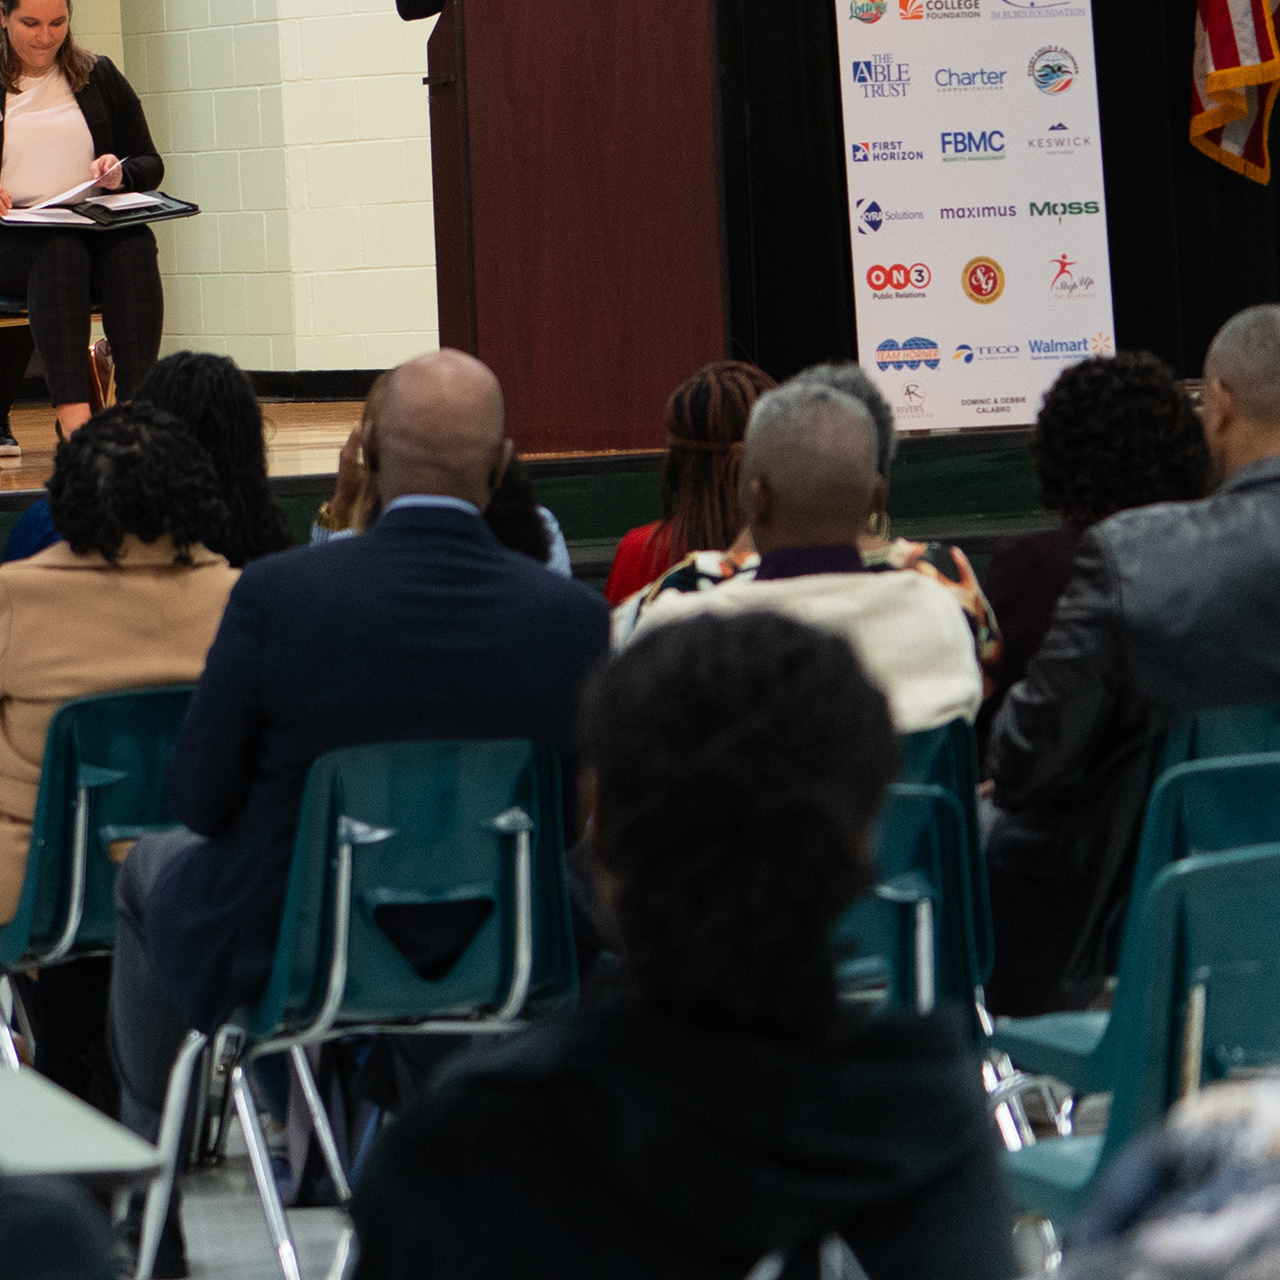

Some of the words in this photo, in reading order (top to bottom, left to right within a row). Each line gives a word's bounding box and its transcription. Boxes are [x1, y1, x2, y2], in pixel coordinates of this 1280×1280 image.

[926, 0, 980, 11] COLLEGE
[926, 10, 981, 19] FOUNDATION
[872, 53, 894, 64] THE
[853, 61, 911, 83] ABLE
[935, 68, 1007, 86] Charter
[861, 83, 910, 98] TRUST
[872, 141, 902, 151] FIRST
[941, 130, 1005, 154] FBMC
[1028, 137, 1092, 148] KESWICK
[872, 151, 924, 161] HORIZON
[940, 205, 1016, 219] maximus
[975, 345, 1019, 354] TECO
[1028, 338, 1088, 352] Walmart
[961, 398, 991, 406] DOMINIC
